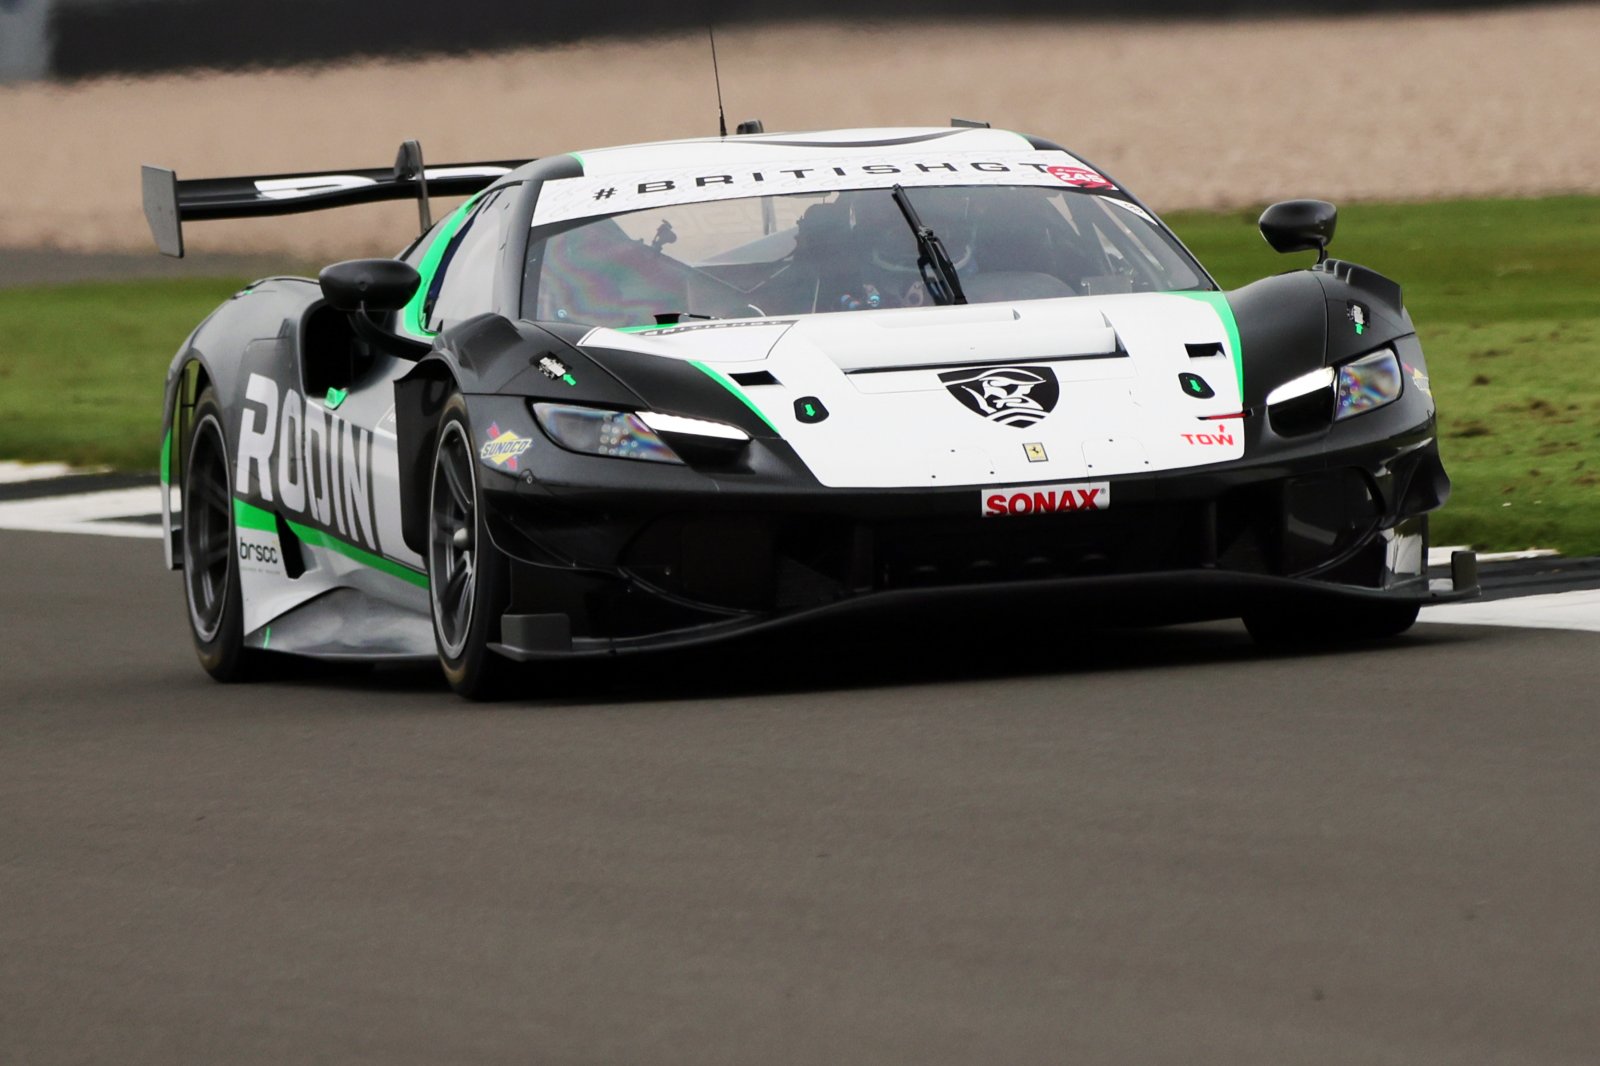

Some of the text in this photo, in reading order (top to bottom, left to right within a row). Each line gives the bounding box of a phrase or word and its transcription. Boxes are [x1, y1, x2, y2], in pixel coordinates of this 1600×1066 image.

[482, 440, 529, 457] SUNOCO
[1181, 433, 1234, 446] TOW
[235, 373, 376, 551] RODIN
[240, 537, 278, 564] brscc
